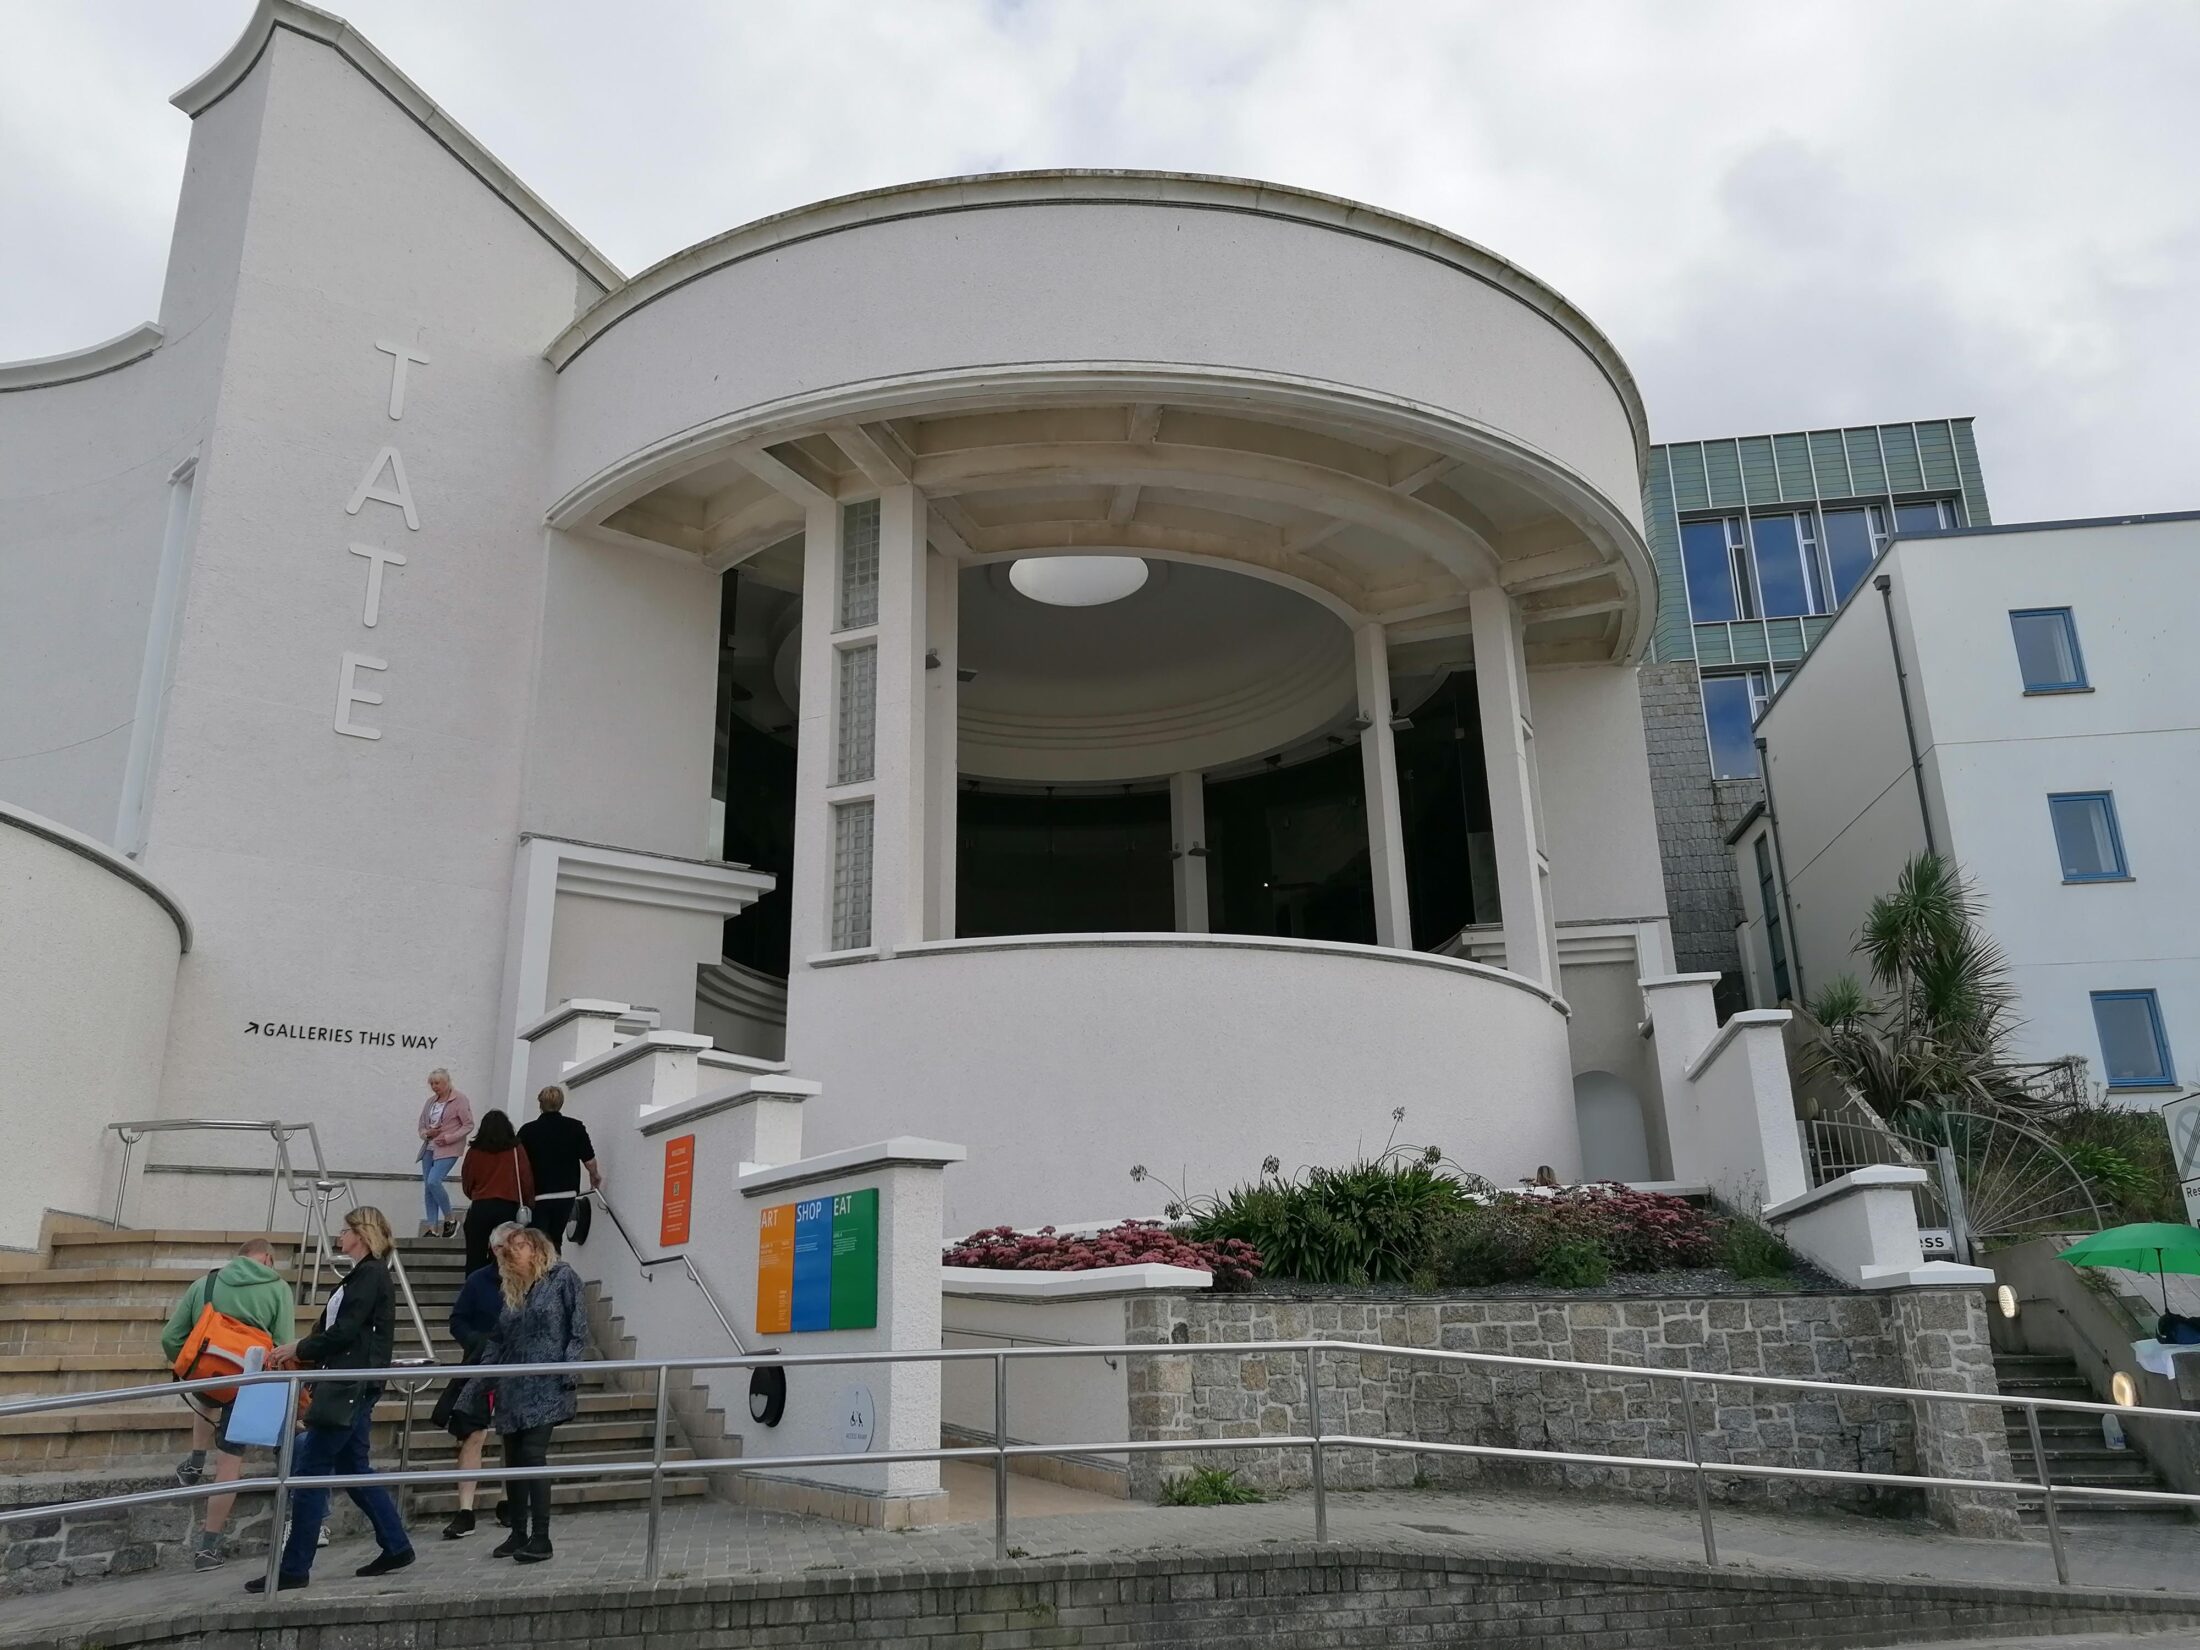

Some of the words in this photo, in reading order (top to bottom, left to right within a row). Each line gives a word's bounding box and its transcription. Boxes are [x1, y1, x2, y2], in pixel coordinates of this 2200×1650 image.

[334, 340, 430, 740] TATE
[263, 1022, 353, 1044] GALLERIES
[359, 1031, 396, 1047] THIS
[402, 1034, 438, 1050] WAY
[796, 1201, 822, 1223] SHOP
[833, 1195, 852, 1217] EAT
[761, 1209, 779, 1229] ART
